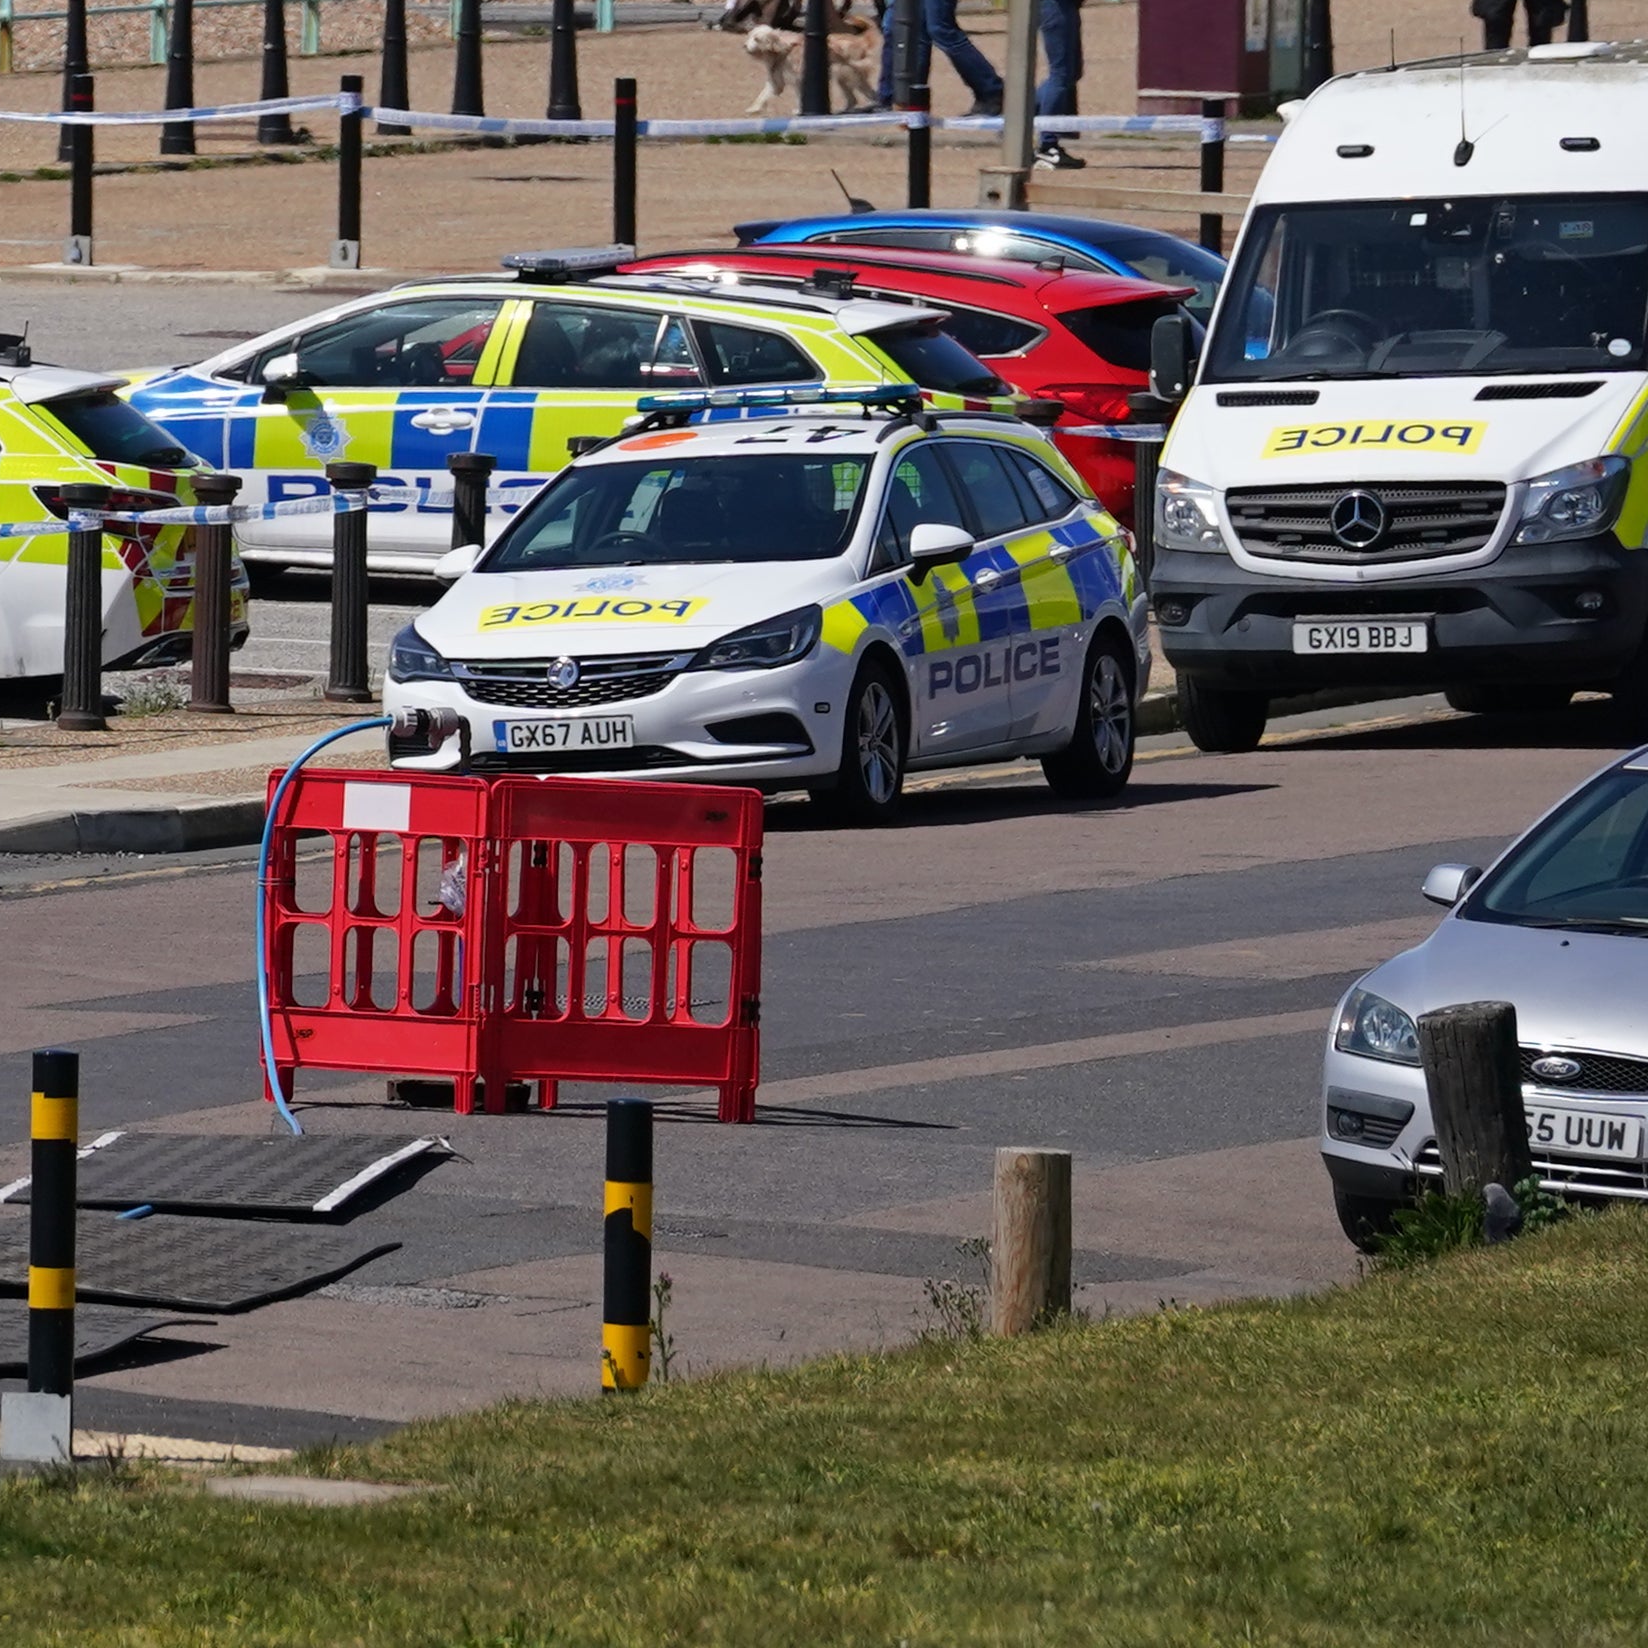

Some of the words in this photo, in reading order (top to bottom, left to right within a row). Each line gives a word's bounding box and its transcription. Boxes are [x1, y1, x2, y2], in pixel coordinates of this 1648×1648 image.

[1309, 628, 1360, 650] GX19
[1368, 627, 1412, 648] BBJ
[928, 637, 1061, 700] POLICE
[510, 722, 572, 748] GX67
[580, 719, 627, 745] AUH
[1541, 1060, 1570, 1074] Ford
[1565, 1115, 1626, 1151] UUW
